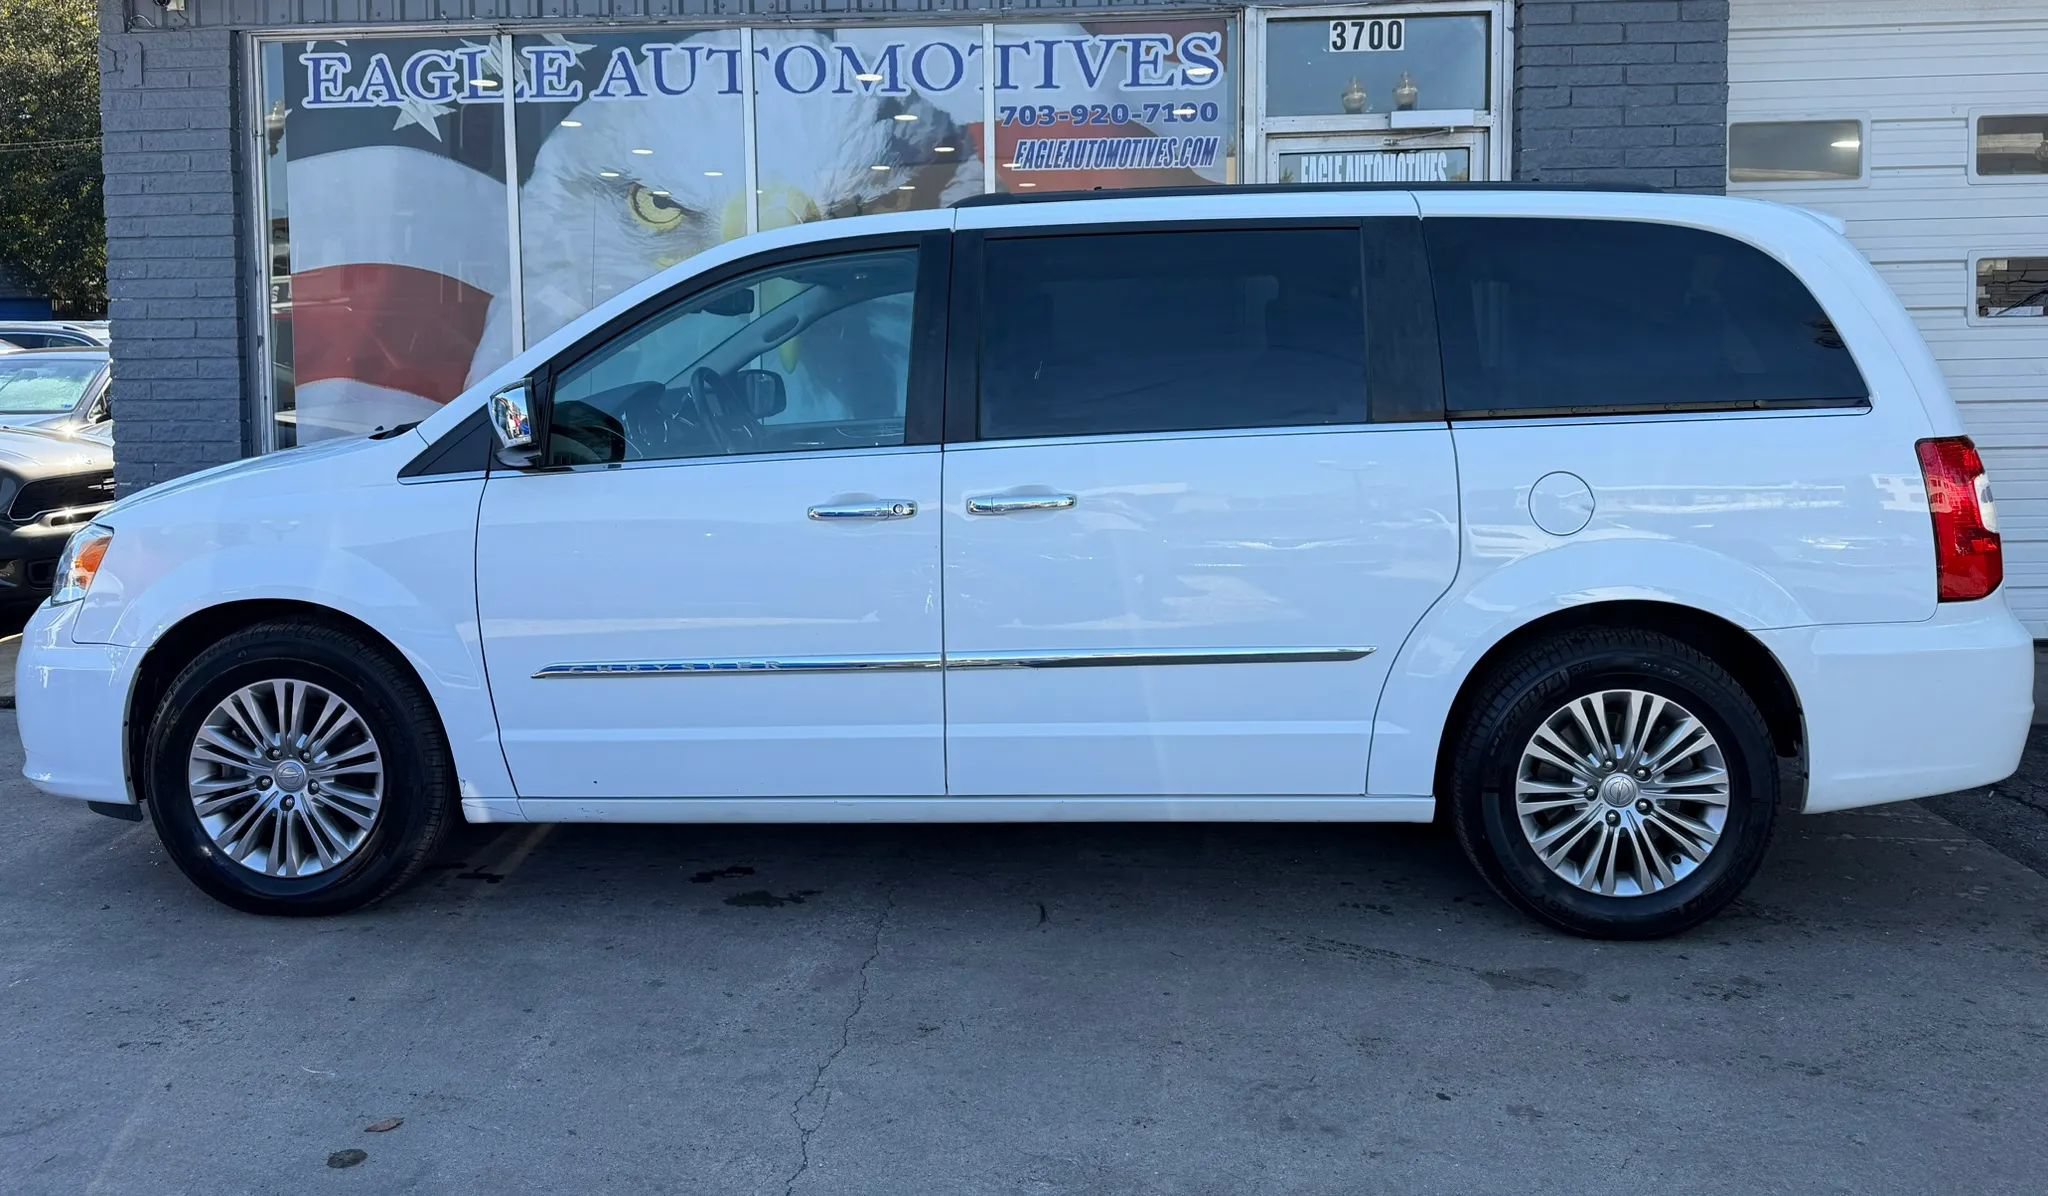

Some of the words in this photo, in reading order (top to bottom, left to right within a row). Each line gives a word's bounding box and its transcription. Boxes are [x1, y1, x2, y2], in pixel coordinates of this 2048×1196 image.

[1332, 20, 1402, 50] 3700
[302, 48, 582, 106] EAGLE
[590, 34, 1223, 99] AUTOMOTIVES
[1000, 102, 1219, 127] 703-920-7100
[1013, 136, 1219, 170] EAGLEAUTOMOTIVES.COM
[1301, 155, 1342, 183] EAGLE
[1346, 152, 1447, 182] AUTOMOTIVES
